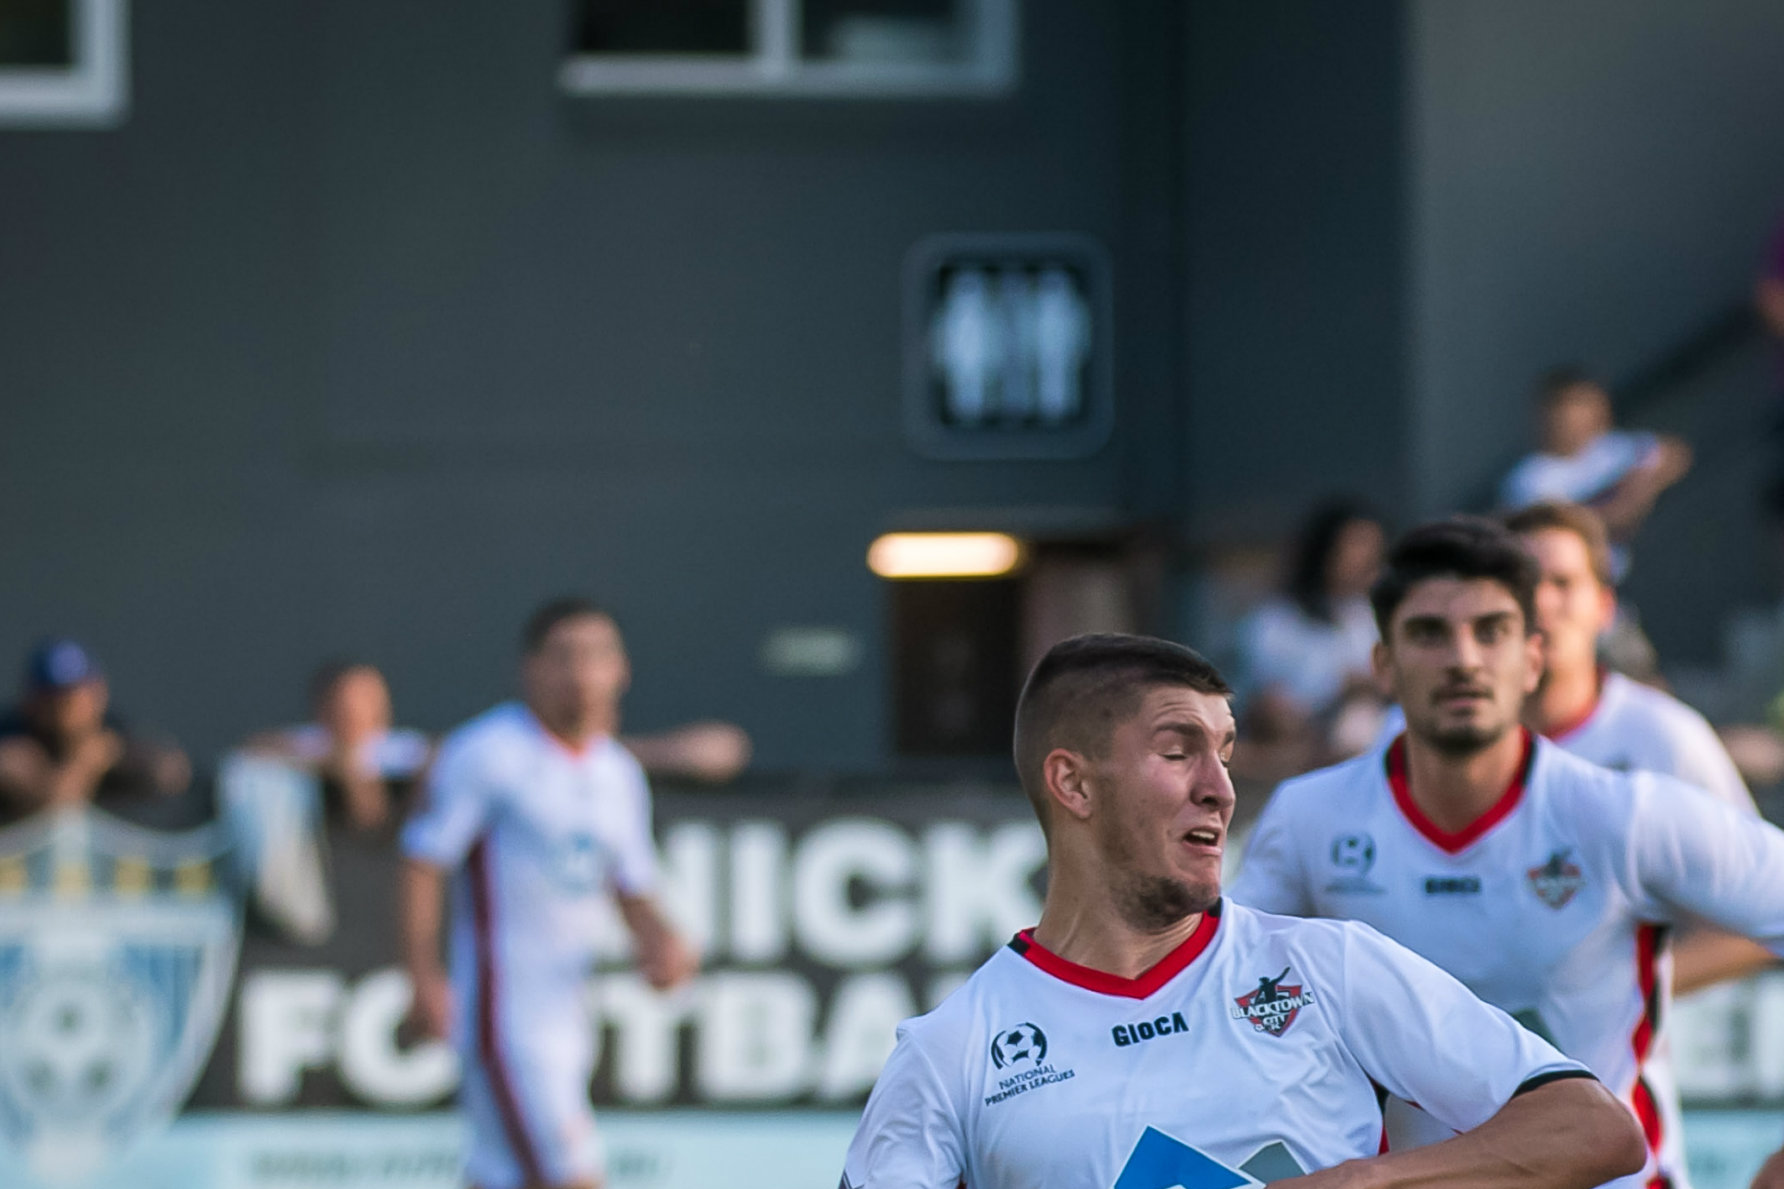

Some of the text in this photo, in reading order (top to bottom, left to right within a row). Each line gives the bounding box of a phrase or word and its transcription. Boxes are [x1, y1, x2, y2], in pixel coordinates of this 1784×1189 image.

[1231, 990, 1315, 1019] BLACKTOWN
[1111, 1011, 1190, 1048] GIOCA
[984, 1068, 1076, 1107] PREMIER LEAGUES
[999, 1063, 1057, 1090] NATIONAL
